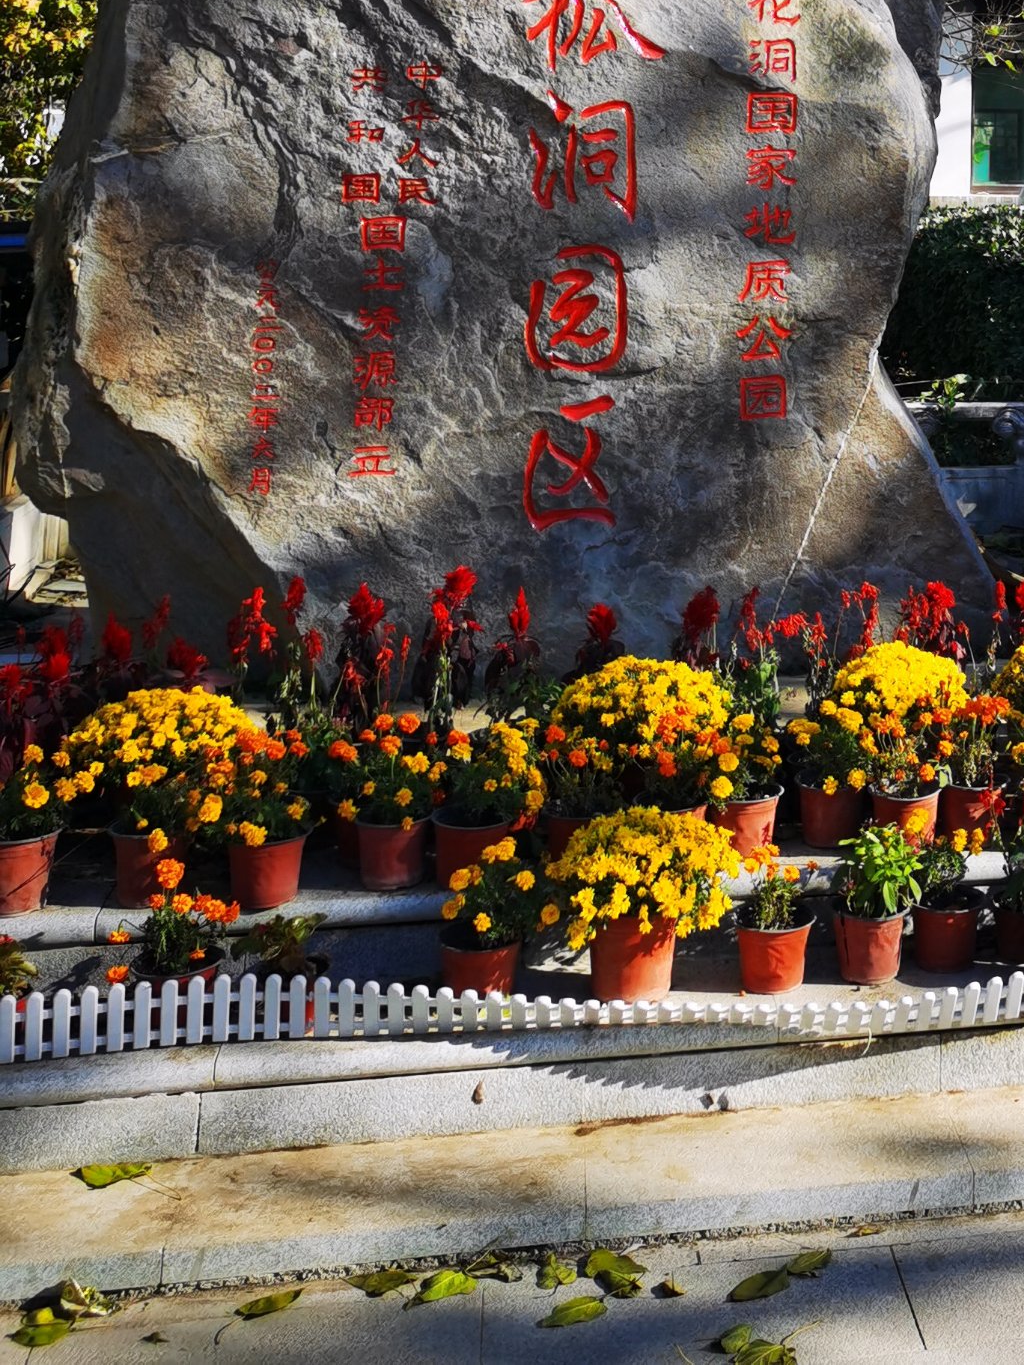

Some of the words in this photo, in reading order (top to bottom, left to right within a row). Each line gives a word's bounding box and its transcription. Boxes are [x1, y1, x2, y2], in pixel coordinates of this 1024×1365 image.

[341, 65, 388, 204] 共和国
[397, 60, 443, 206] 中华人民
